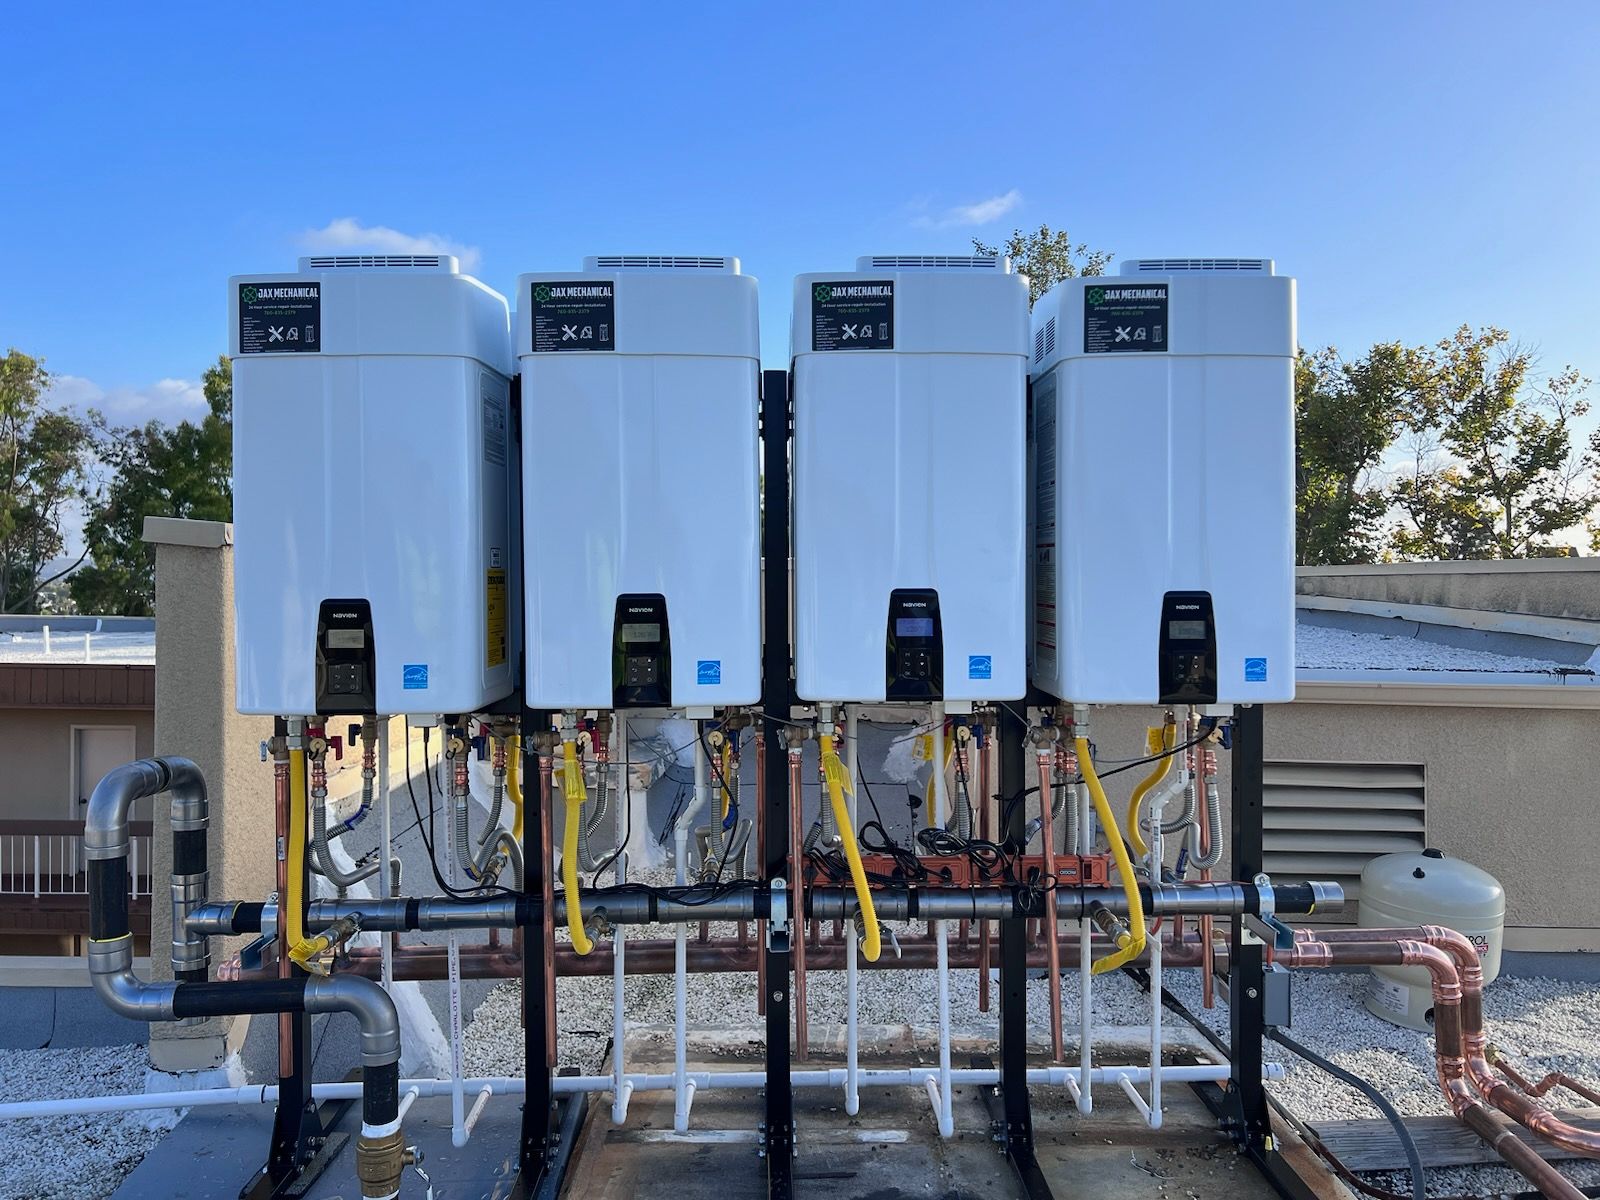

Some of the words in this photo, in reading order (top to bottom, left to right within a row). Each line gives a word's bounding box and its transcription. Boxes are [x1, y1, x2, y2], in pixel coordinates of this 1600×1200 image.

[258, 288, 273, 298] JAX
[274, 288, 318, 298] MECHANICAL
[551, 288, 566, 297] JAX
[567, 287, 612, 296] MECHANICAL
[832, 287, 846, 296] JAX
[848, 286, 892, 296] MECHANICAL
[1105, 290, 1120, 299] JAX
[1121, 289, 1167, 299] MECHANICAL
